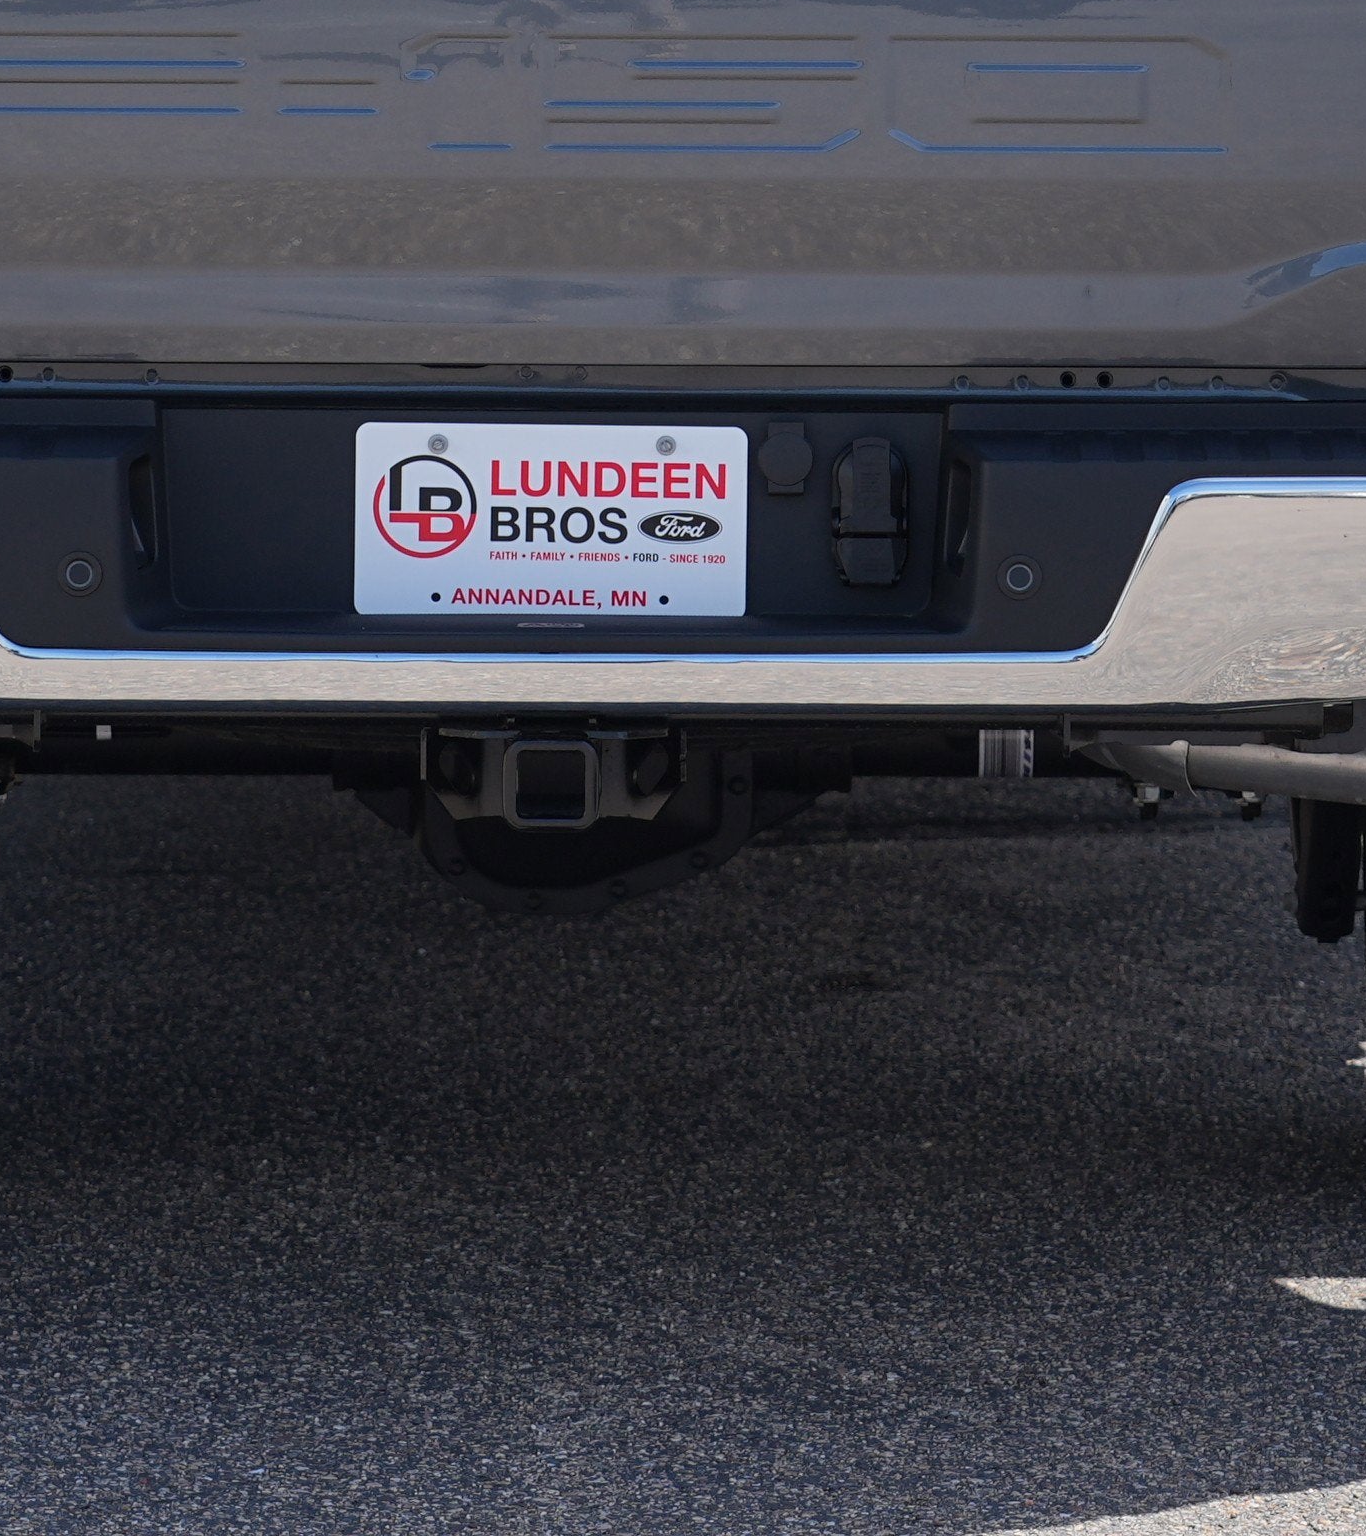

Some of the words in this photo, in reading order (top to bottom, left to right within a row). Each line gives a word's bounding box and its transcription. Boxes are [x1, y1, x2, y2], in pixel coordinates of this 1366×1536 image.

[490, 459, 727, 499] LUNDEEN
[490, 506, 628, 544] BROS
[489, 550, 518, 561] FAITH
[530, 551, 566, 562] FAMILY
[578, 552, 621, 563] FRIENDS
[633, 553, 660, 563] FORD
[669, 554, 700, 564] SINCE
[702, 554, 726, 564] 1920
[451, 588, 603, 609] ANNANDALE,
[611, 591, 648, 606] MN
